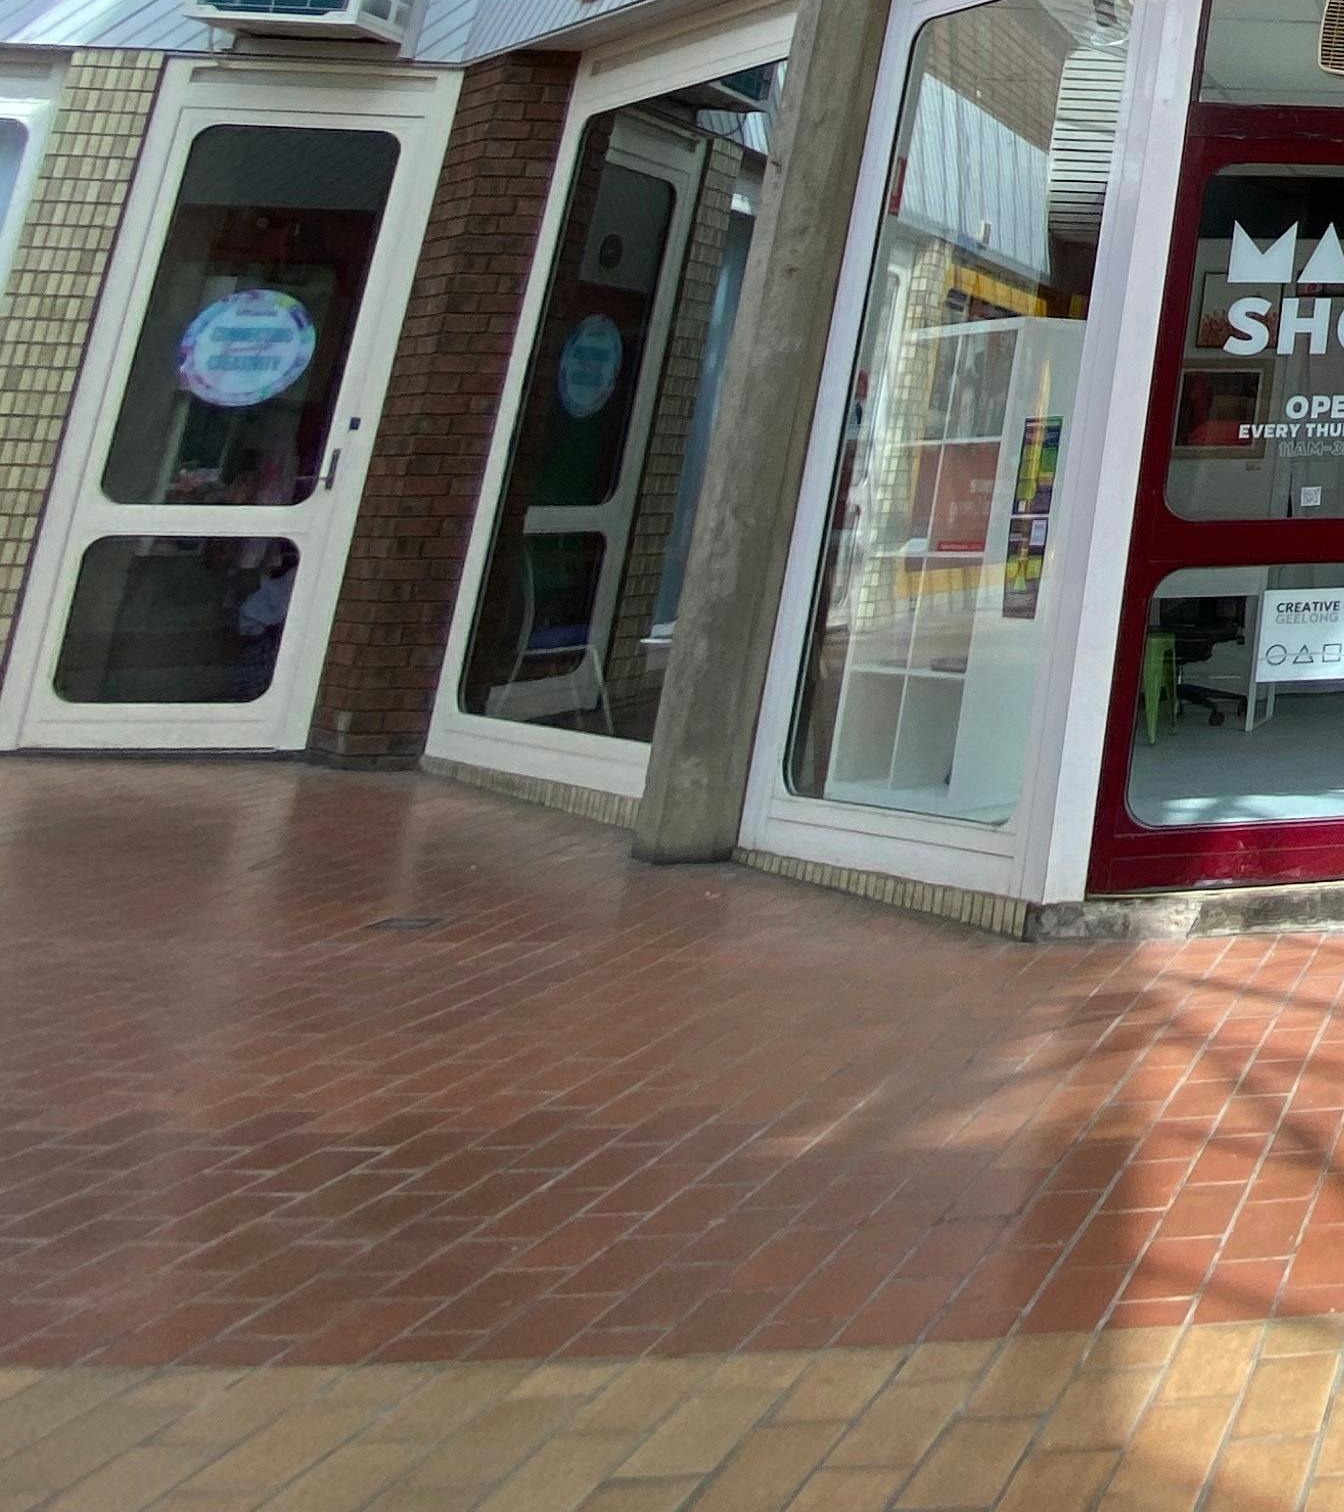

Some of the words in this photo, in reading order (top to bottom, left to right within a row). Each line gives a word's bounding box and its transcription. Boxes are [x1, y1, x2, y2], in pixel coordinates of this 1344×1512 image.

[1238, 423, 1300, 439] EVERY
[1276, 600, 1341, 614] CREATIVE
[1275, 612, 1339, 625] GEELONG
